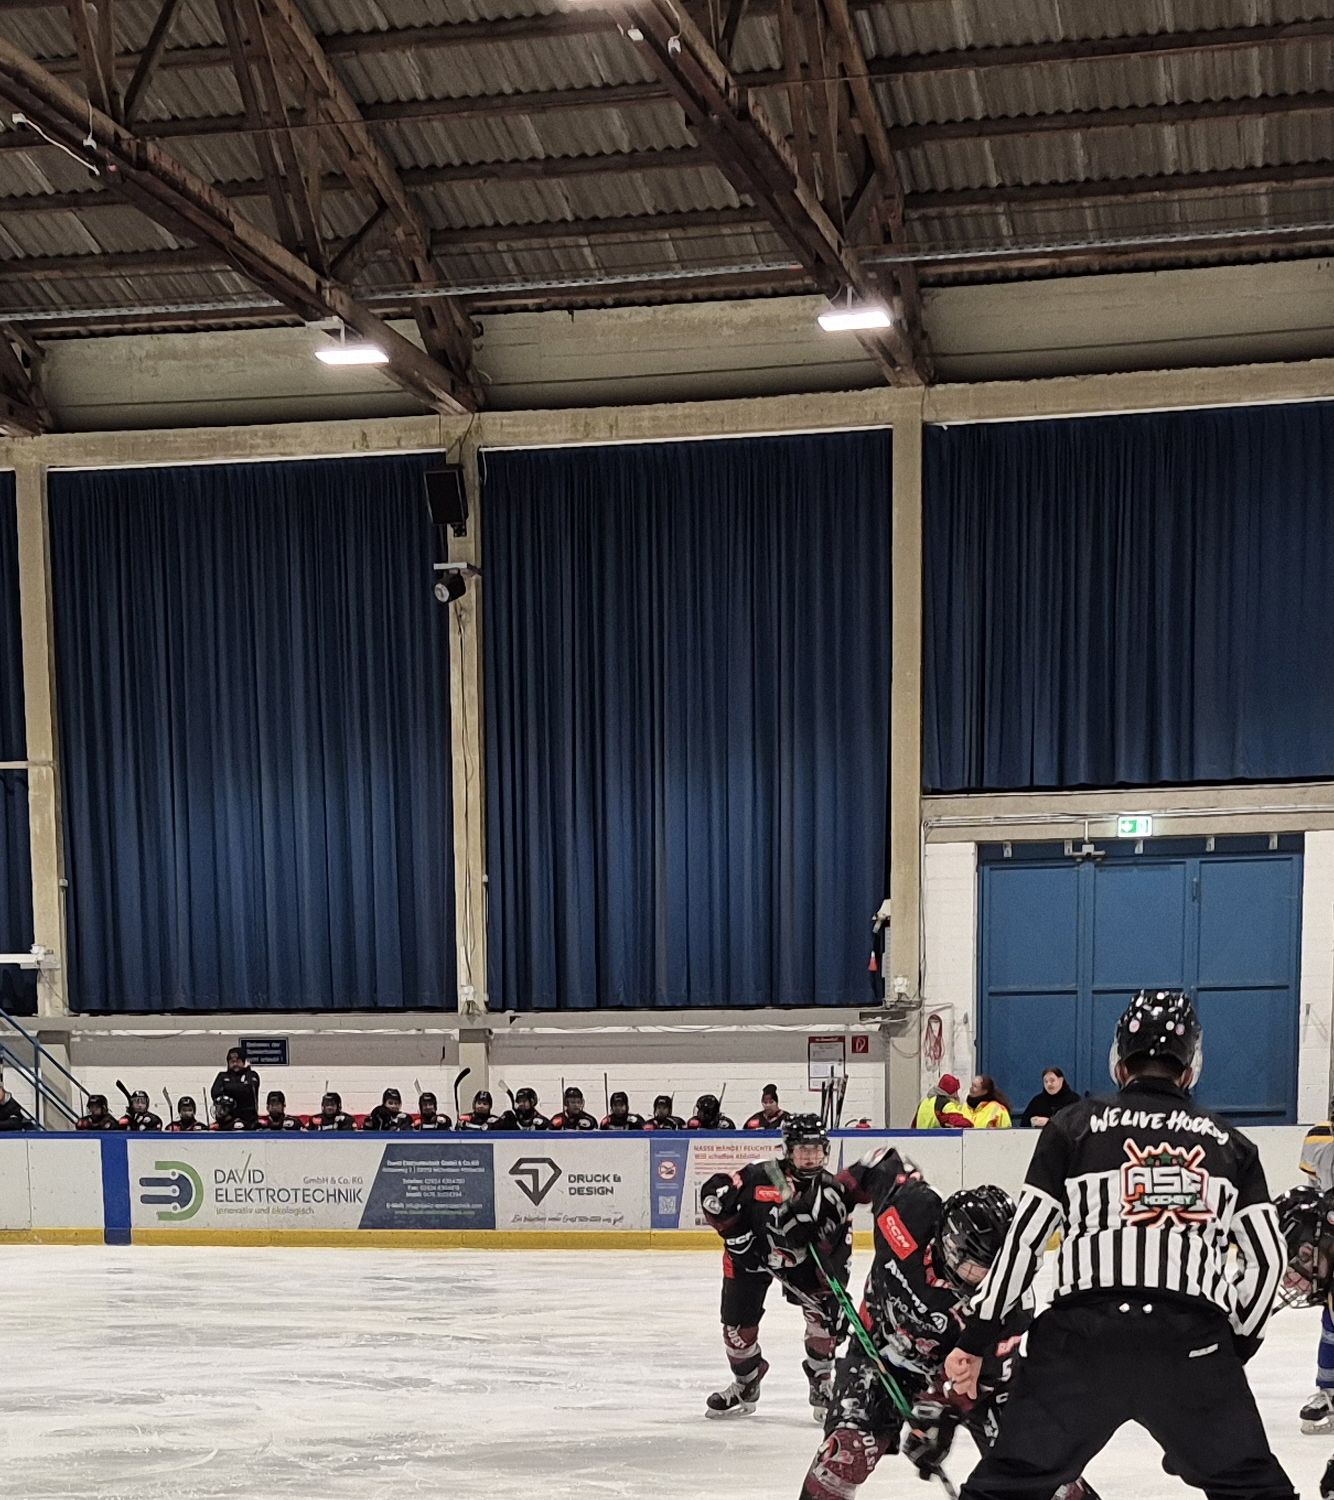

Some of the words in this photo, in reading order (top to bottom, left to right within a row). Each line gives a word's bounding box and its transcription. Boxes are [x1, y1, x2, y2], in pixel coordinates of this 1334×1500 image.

[1121, 1109, 1167, 1130] LIVE
[214, 1153, 265, 1185] DAVID
[568, 1174, 611, 1184] DRUCK
[215, 1187, 365, 1204] ELEKTROTECHNIK
[568, 1186, 614, 1196] DESIGN
[255, 1206, 271, 1215] und
